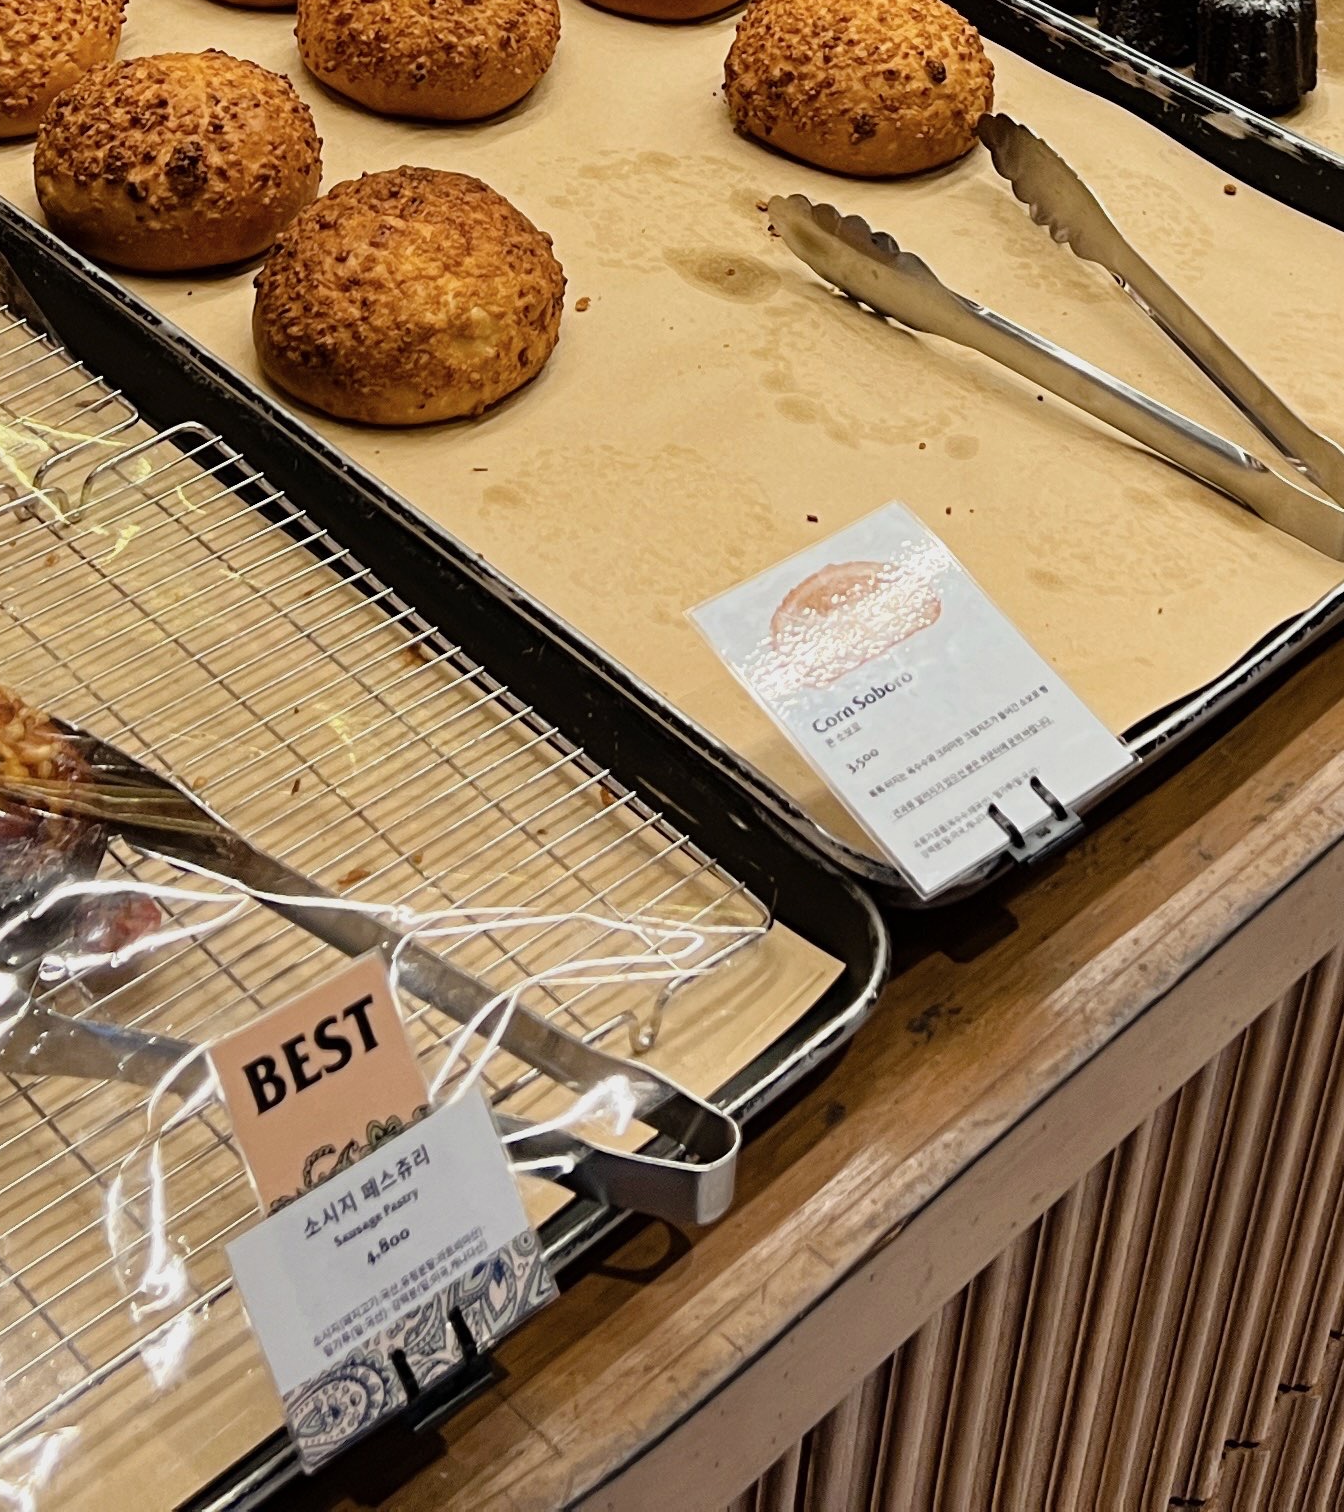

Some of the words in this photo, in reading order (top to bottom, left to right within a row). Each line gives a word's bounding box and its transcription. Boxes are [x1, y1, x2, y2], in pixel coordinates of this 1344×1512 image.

[812, 705, 856, 733] Corn
[852, 672, 913, 710] Soboro
[846, 748, 880, 774] 3,500
[242, 994, 379, 1116] BEST
[304, 1190, 358, 1239] 소시지
[360, 1143, 430, 1200] 페스츄리
[334, 1212, 383, 1248] Sausage
[383, 1188, 419, 1217] Pastry
